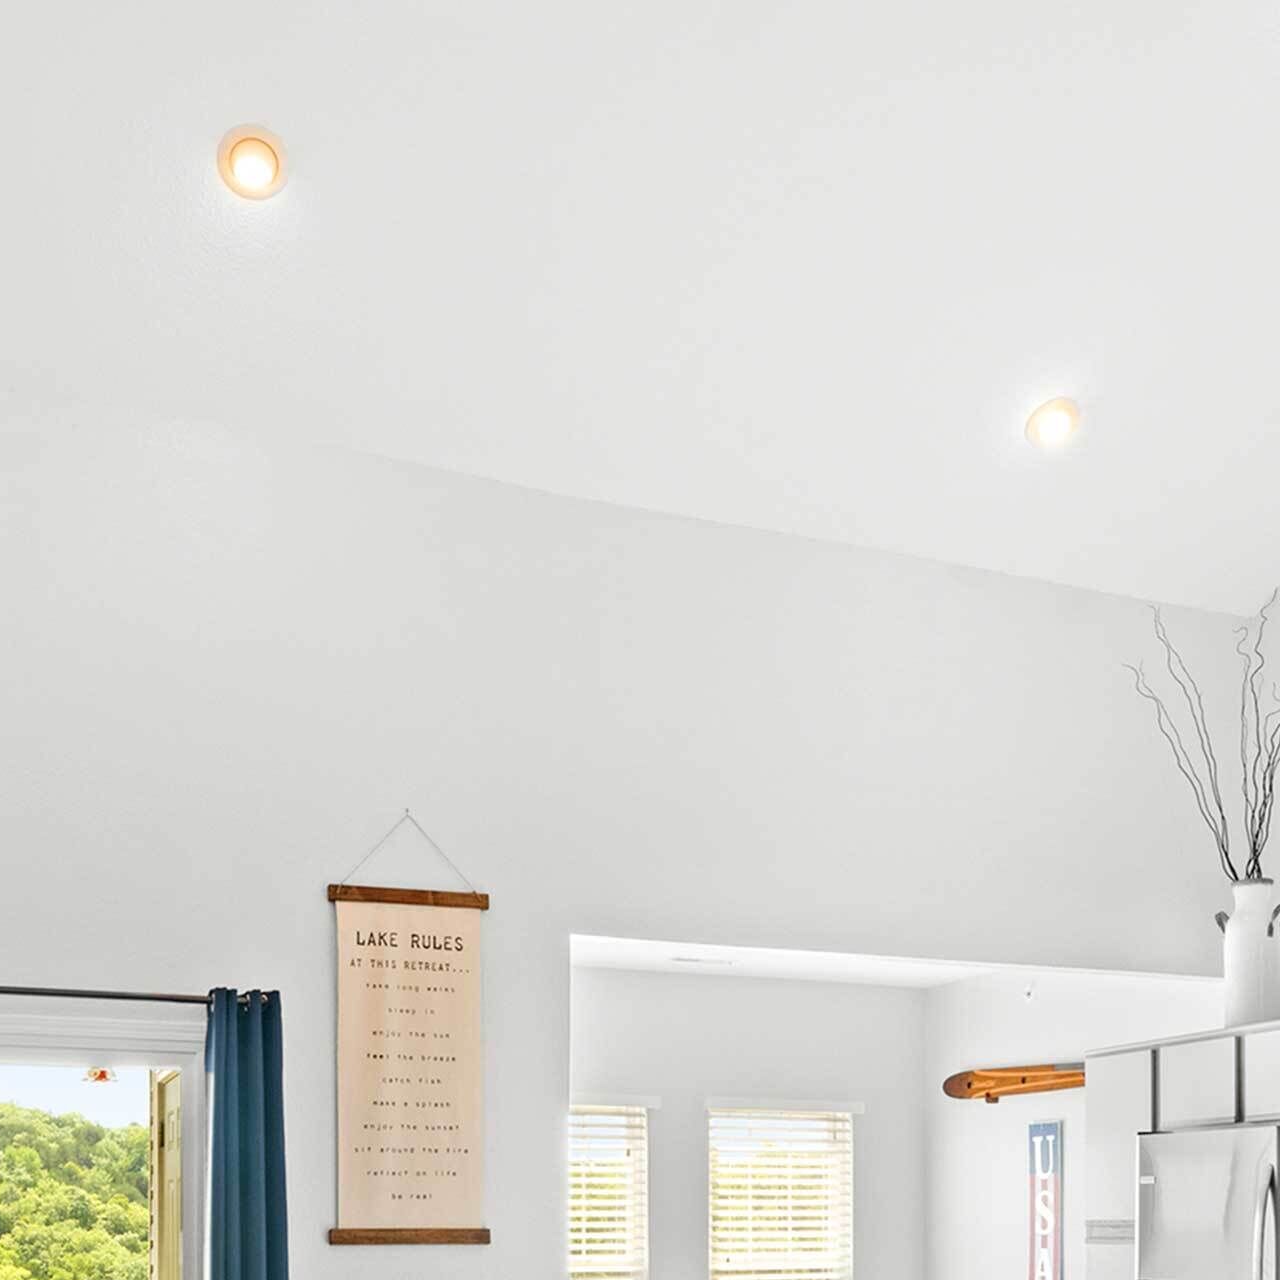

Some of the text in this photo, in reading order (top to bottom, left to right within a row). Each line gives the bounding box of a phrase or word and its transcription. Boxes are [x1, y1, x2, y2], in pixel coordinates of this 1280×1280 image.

[356, 931, 464, 951] LAKE RULES
[349, 958, 362, 968] AT
[370, 959, 397, 969] THIS
